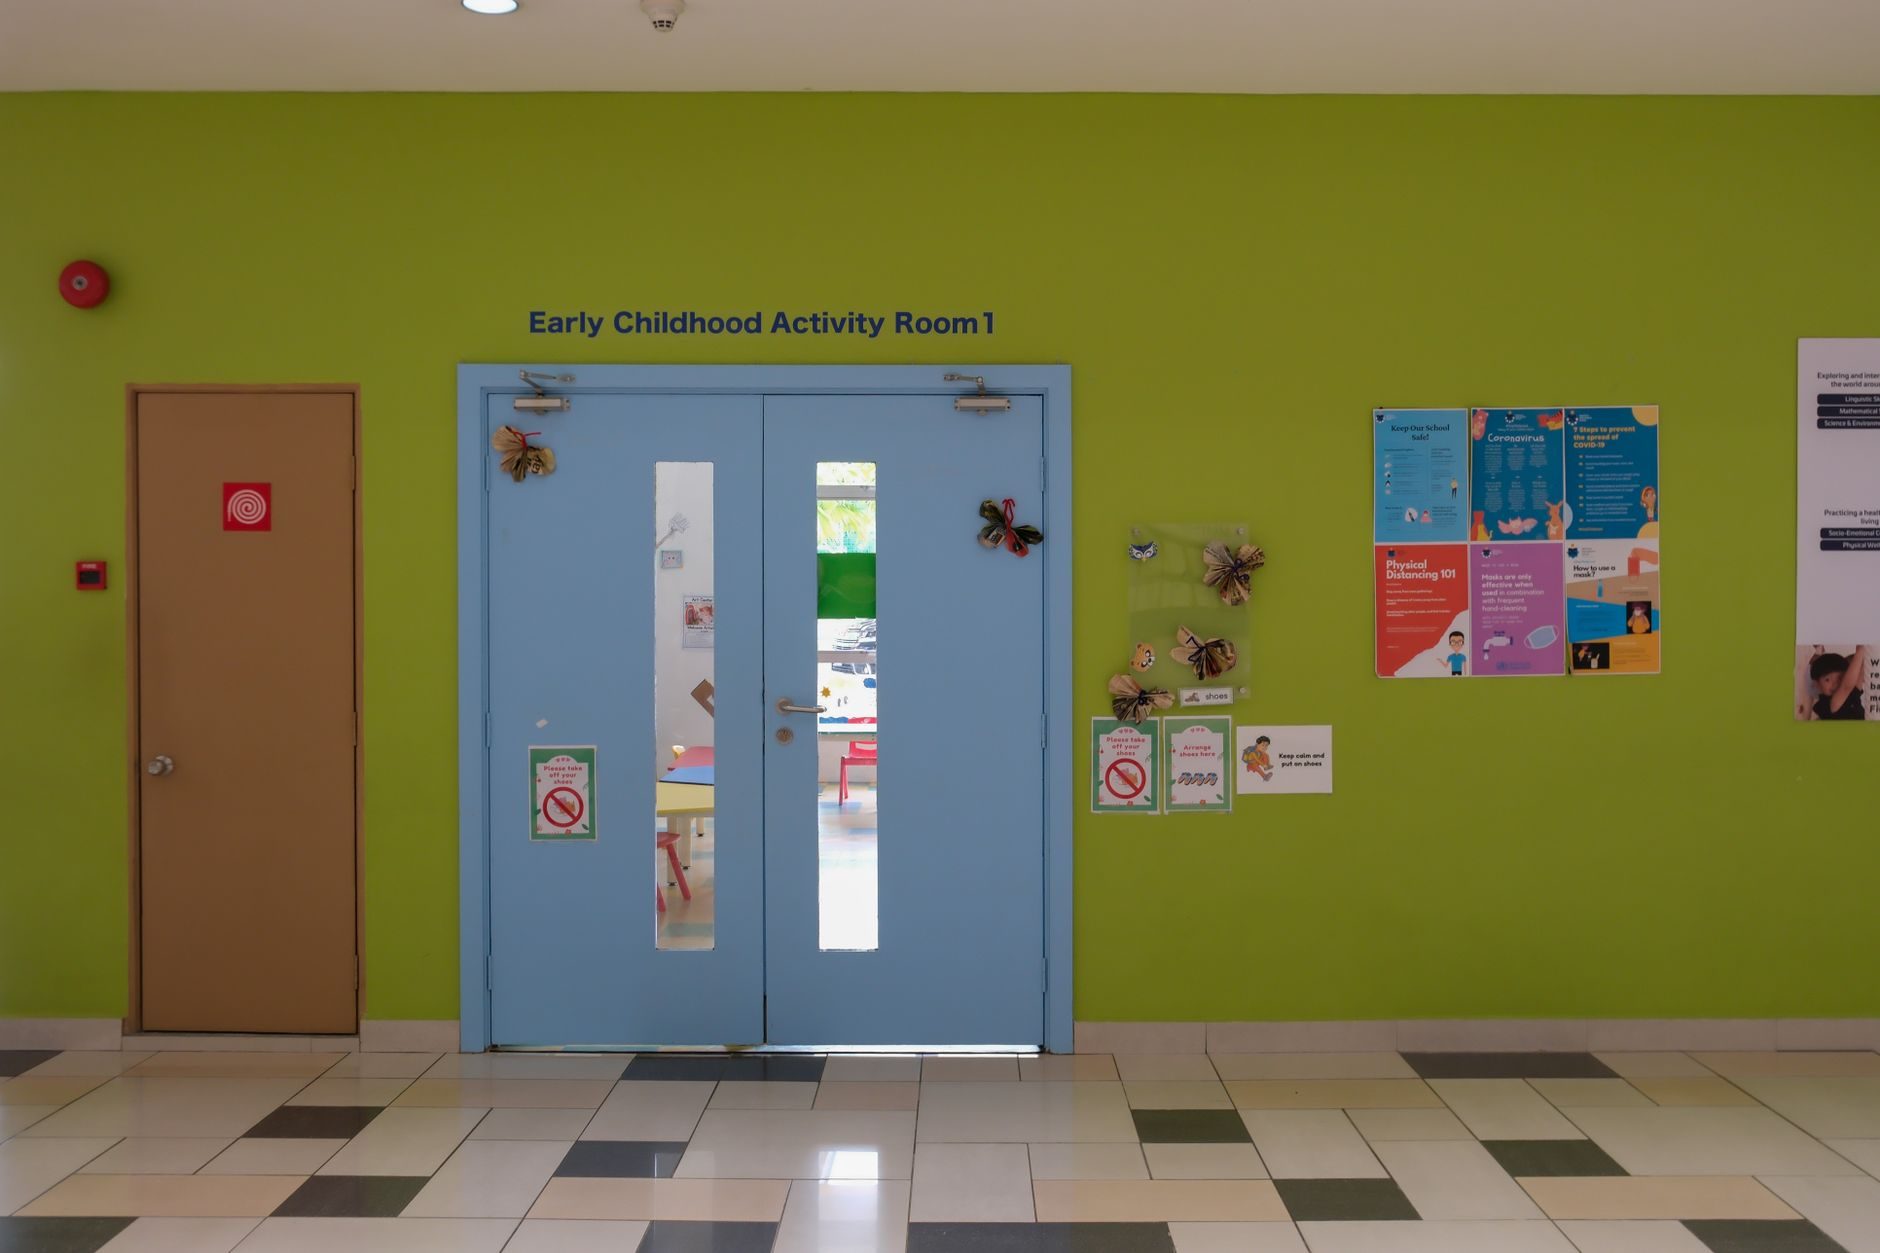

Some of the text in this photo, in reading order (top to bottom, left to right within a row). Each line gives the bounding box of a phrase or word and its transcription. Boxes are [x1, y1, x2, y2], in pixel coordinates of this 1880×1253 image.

[528, 310, 604, 339] Early
[613, 310, 762, 335] Childhood
[770, 310, 885, 338] Activity
[1817, 372, 1850, 380] Exploring
[1391, 424, 1409, 433] Keep
[1425, 424, 1450, 432] School
[1580, 426, 1599, 434] Steps
[1608, 426, 1636, 434] prevent
[1488, 433, 1545, 442] Coronavirus
[1586, 434, 1610, 442] spread
[1824, 509, 1858, 517] Practicing
[1386, 560, 1428, 572] Physical
[1386, 569, 1456, 581] Distancing 101
[1497, 597, 1525, 605] frequent
[1205, 692, 1228, 702] shoes
